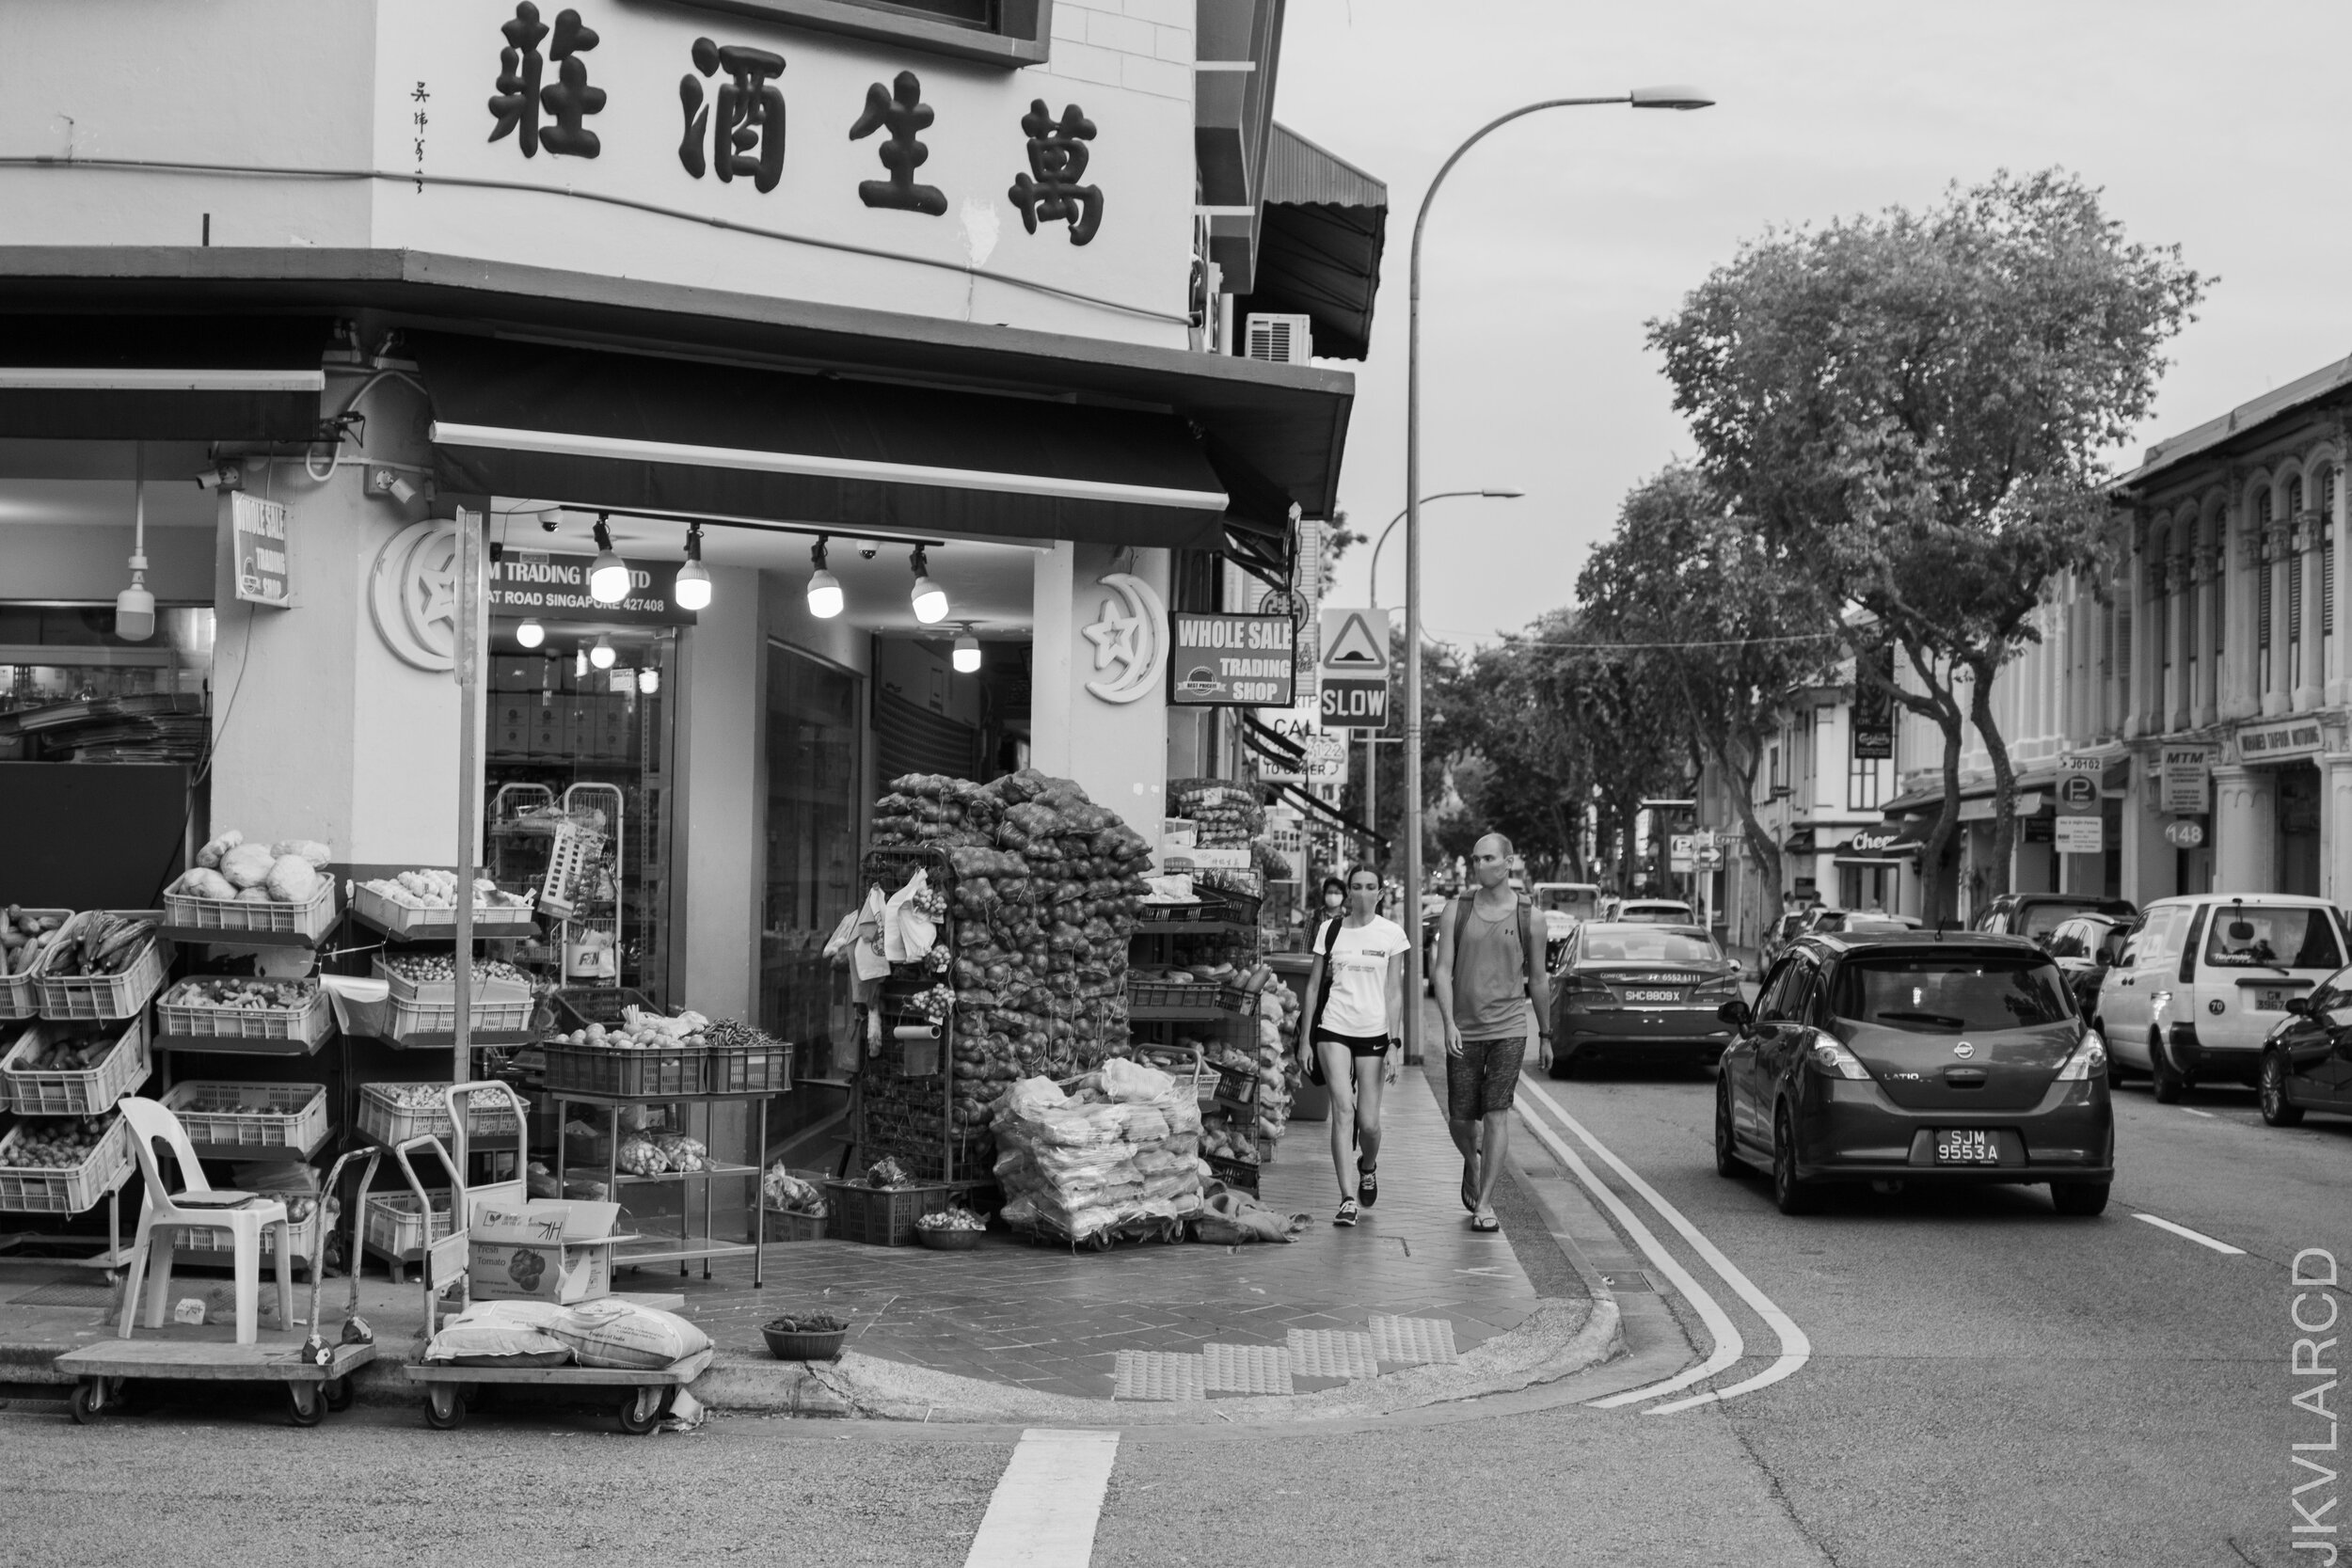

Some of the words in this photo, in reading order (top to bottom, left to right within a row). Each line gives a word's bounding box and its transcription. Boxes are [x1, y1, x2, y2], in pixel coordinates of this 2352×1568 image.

[504, 562, 580, 585] TRADING
[628, 570, 651, 589] TD
[263, 578, 281, 600] SHOP
[504, 591, 543, 606] ROAD
[623, 598, 664, 612] 427408
[1179, 620, 1245, 649] WHOLE
[1248, 622, 1292, 650] SALE
[1220, 657, 1291, 678] TRADING
[1232, 682, 1278, 701] SHOP
[1322, 689, 1385, 716] SLOW
[1274, 719, 1331, 737] CALL
[2071, 759, 2101, 769] J0102
[2167, 753, 2204, 764] MTM
[2070, 779, 2090, 801] P
[2167, 826, 2202, 843] 148
[2211, 1002, 2223, 1011] 70
[1884, 1072, 1919, 1081] LATIO
[1951, 1130, 1985, 1145] SJM
[1938, 1145, 1997, 1160] 9553A
[477, 1244, 500, 1255] Fresh
[476, 1256, 506, 1267] Tomato
